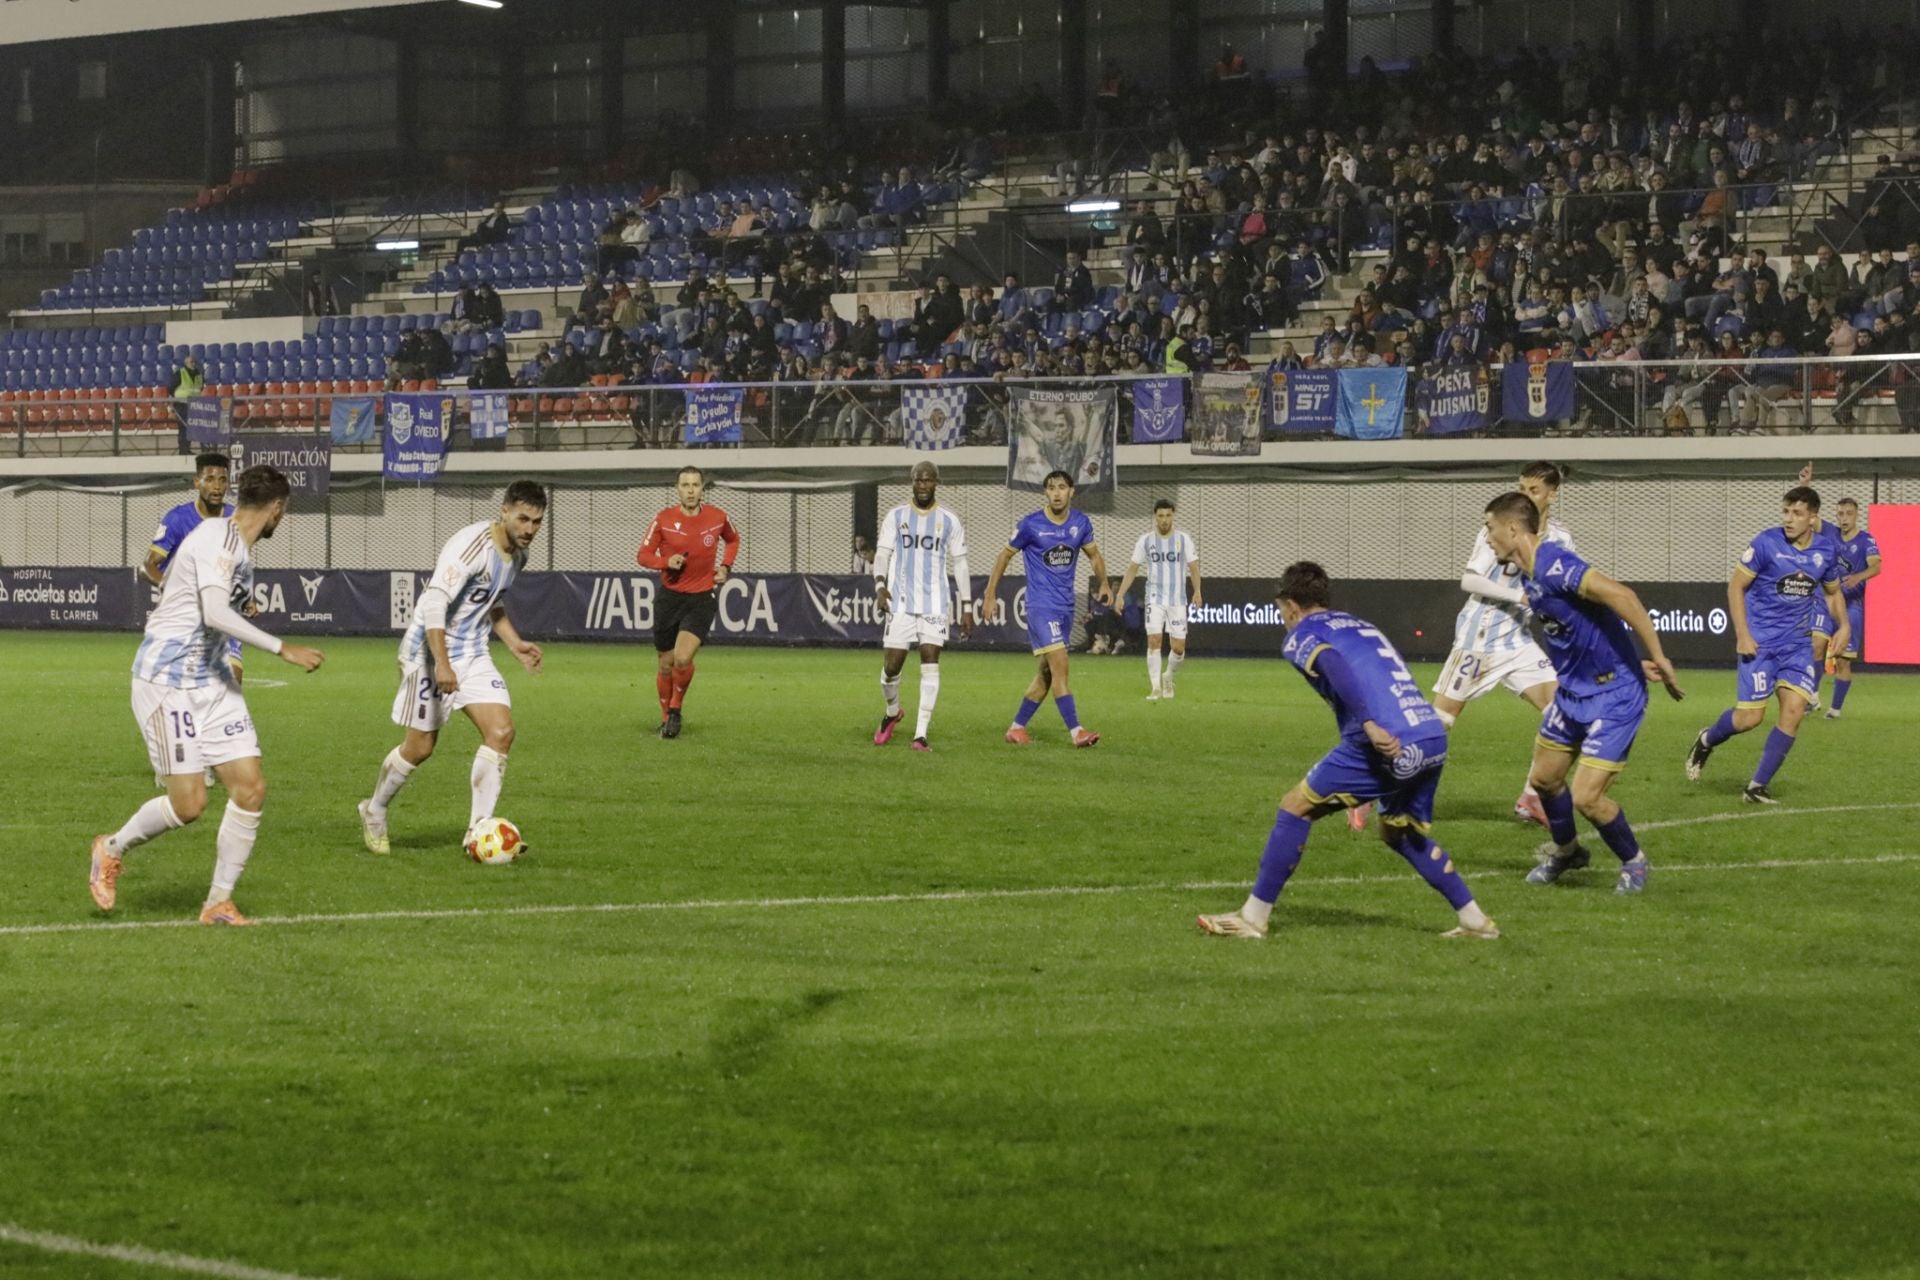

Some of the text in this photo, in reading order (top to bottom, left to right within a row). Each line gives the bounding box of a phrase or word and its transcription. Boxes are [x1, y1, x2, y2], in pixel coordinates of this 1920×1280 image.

[1295, 384, 1330, 392] MINUTO
[1437, 369, 1472, 393] PEÑA
[1030, 391, 1063, 401] ETERNO
[1430, 394, 1475, 417] LUISMI
[419, 408, 433, 420] Real
[702, 404, 729, 420] Orgullo
[414, 425, 439, 438] OVIEDO
[251, 446, 328, 467] DEPUTACIÓN
[901, 534, 943, 552] DIGI
[1151, 552, 1181, 563] DIGI
[14, 569, 53, 580] HOSPITAL
[12, 583, 98, 604] recoletas salud
[602, 577, 779, 633] ABCA
[1187, 603, 1241, 624] Estrella
[50, 609, 99, 621] EL CARMEN
[290, 612, 333, 622] CUPRA
[1357, 628, 1413, 682] 3
[1459, 654, 1482, 679] 21
[1751, 671, 1766, 693] 16
[170, 710, 196, 739] 19
